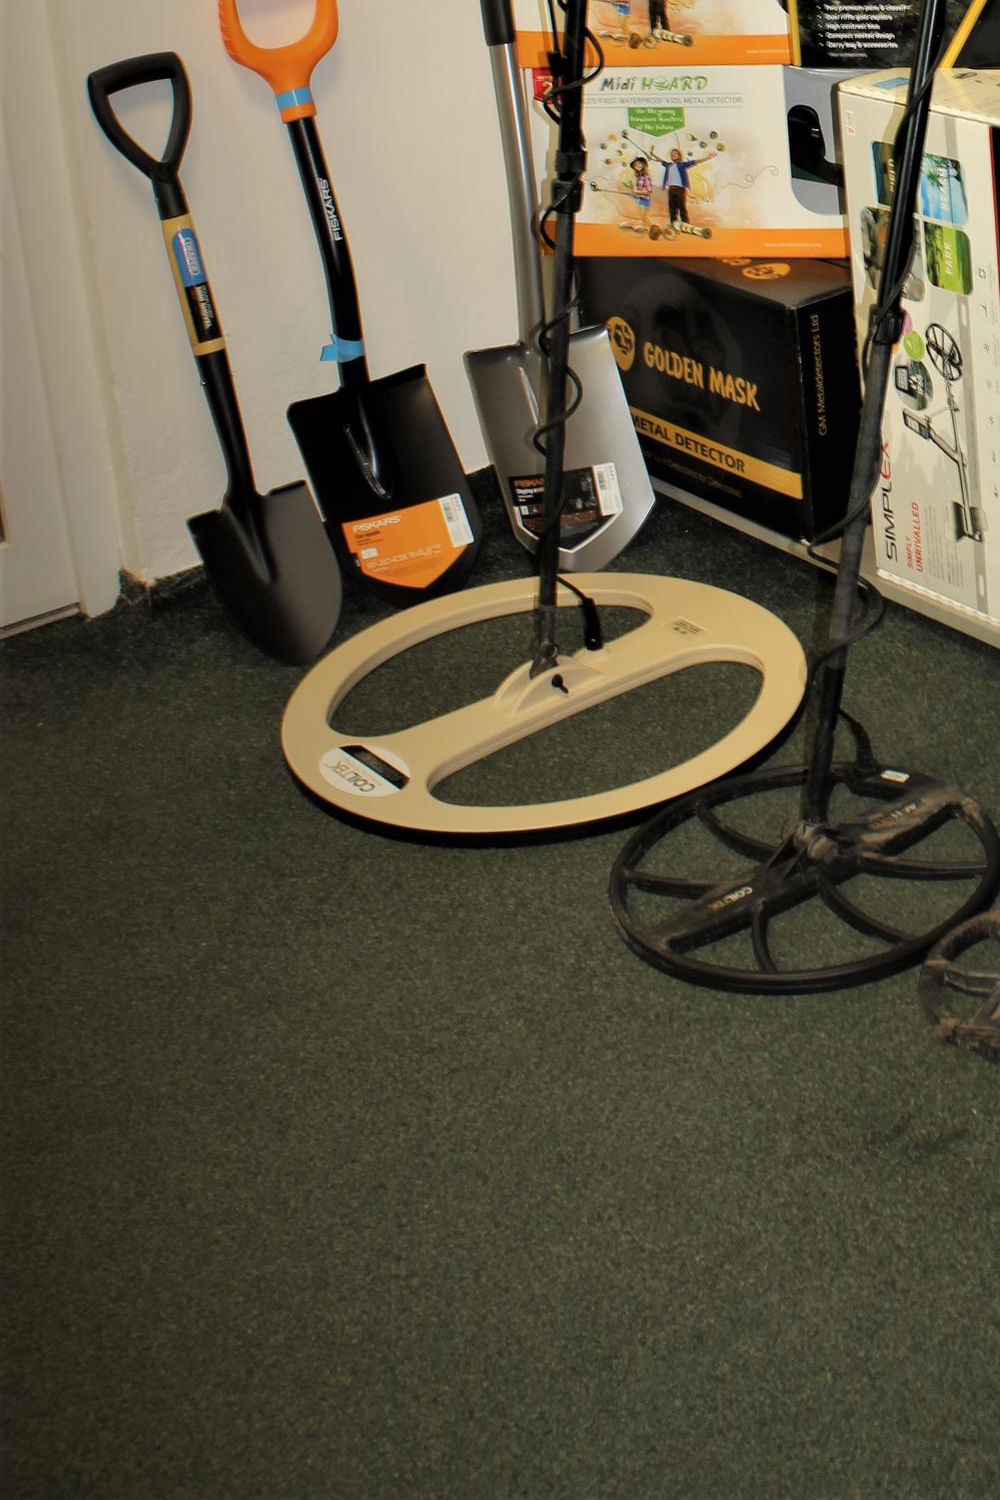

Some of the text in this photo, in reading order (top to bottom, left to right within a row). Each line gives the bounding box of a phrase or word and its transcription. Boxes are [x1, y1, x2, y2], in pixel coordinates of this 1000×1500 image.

[600, 76, 638, 92] Midi
[683, 96, 705, 105] METAL
[319, 178, 343, 242] FISKARS
[945, 242, 954, 277] PARK
[643, 341, 761, 412] GOLDEN MASK
[809, 314, 828, 437] GM Metaldetectors Ltd
[675, 431, 746, 474] DETECTOR
[514, 479, 544, 489] FISKA
[352, 515, 401, 533] FISKARS
[911, 501, 924, 573] UNRIVALLED
